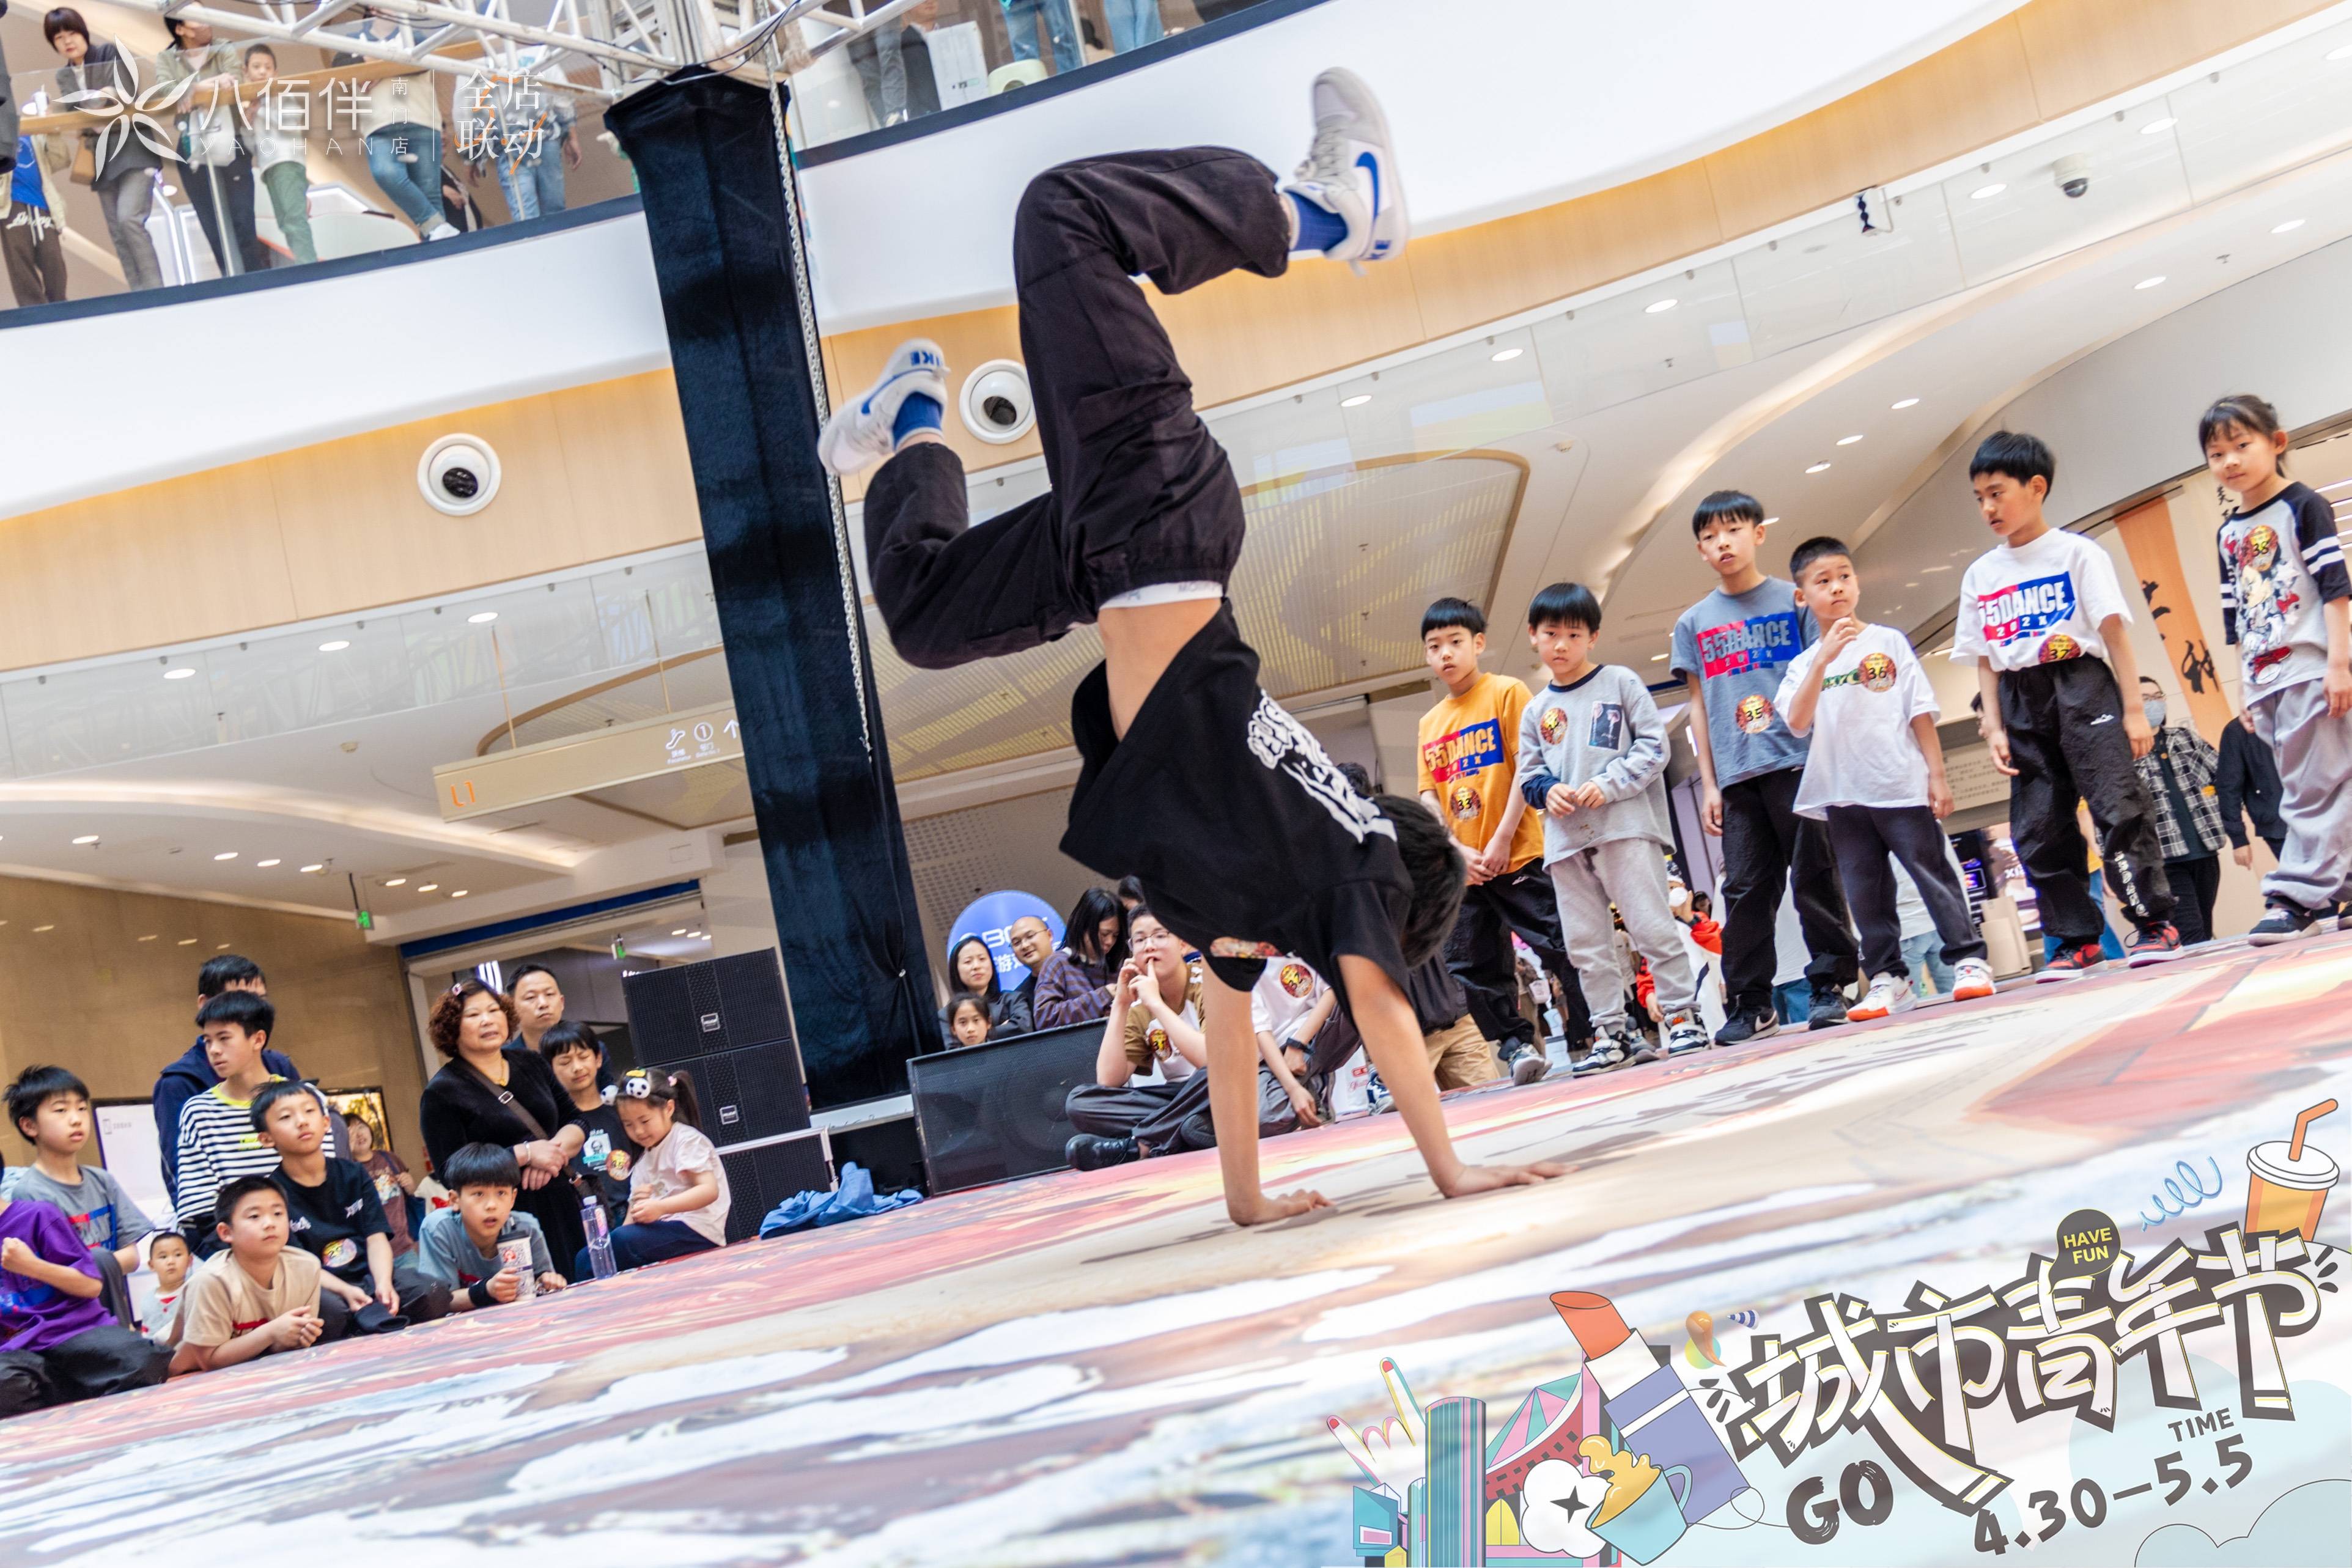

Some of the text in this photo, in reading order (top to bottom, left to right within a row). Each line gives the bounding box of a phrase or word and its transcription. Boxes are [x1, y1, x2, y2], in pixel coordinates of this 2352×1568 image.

[1702, 620, 1791, 663] 55DANCE
[1868, 666, 1887, 680] 36
[1746, 705, 1764, 721] 35
[1425, 726, 1497, 772] 55DANCE
[450, 780, 476, 808] L1
[1458, 798, 1472, 811] 33
